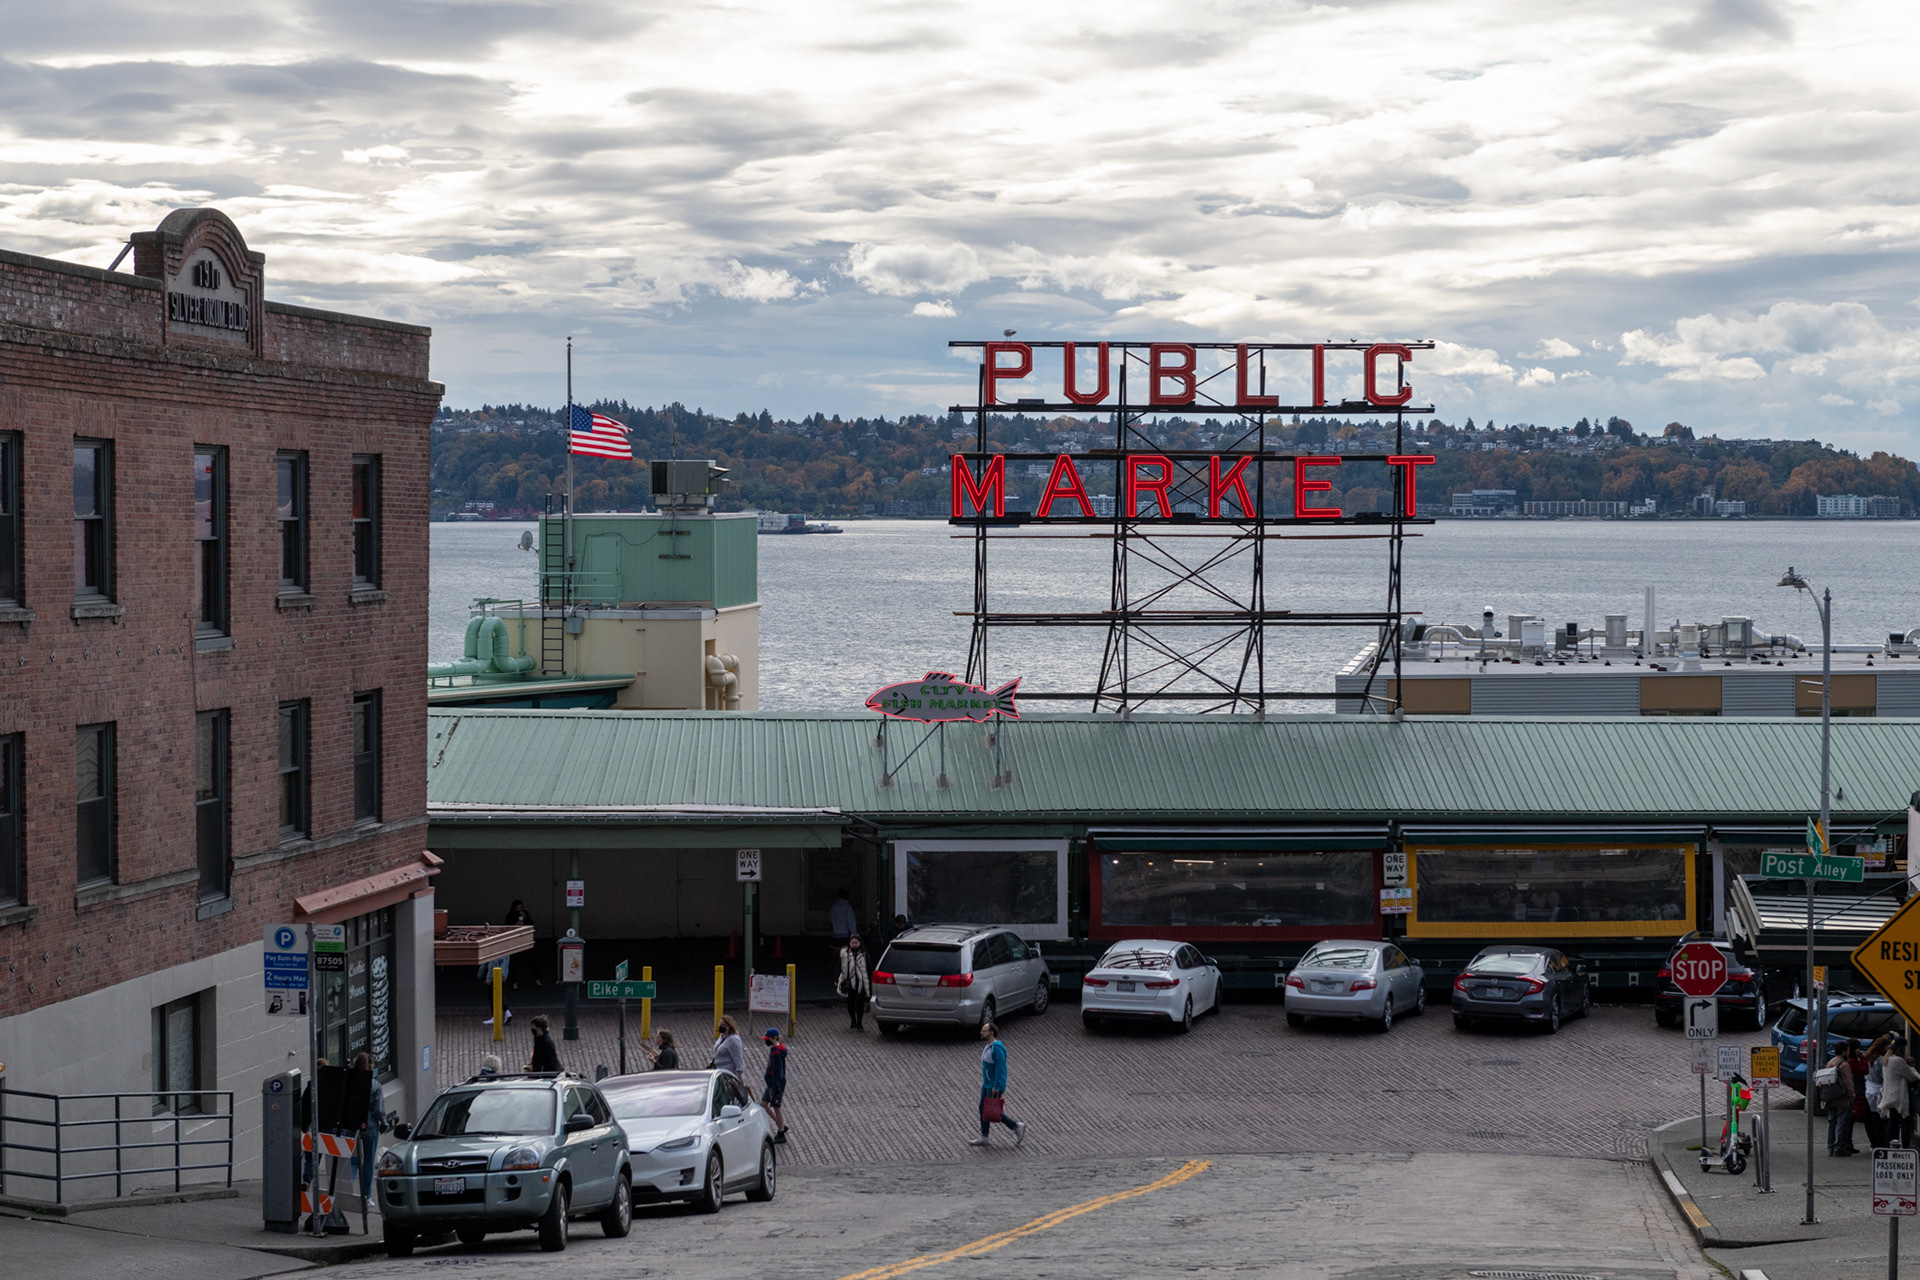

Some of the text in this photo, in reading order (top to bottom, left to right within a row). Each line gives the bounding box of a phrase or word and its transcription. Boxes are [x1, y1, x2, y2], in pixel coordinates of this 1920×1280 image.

[197, 260, 220, 289] 1910
[984, 341, 1413, 407] PUBLIC
[951, 453, 1437, 518] MARKET
[920, 684, 966, 695] CITY
[881, 699, 1001, 709] FISH MARKET
[739, 851, 758, 859] ONE
[1386, 854, 1405, 864] ONE
[739, 860, 759, 868] WAY
[1385, 864, 1405, 873] WAY
[1766, 855, 1861, 880] Post Alley 75
[280, 932, 292, 946] P
[1880, 940, 1919, 962] RESI
[265, 954, 277, 962] Pay
[316, 957, 343, 965] 87505
[1676, 960, 1723, 980] STOP
[266, 971, 273, 981] 2
[593, 983, 618, 995] Pike
[625, 987, 633, 995] Pl
[349, 1020, 366, 1035] BAKERY
[1688, 1028, 1715, 1037] ONLY
[1878, 1151, 1885, 1159] 3
[1876, 1162, 1914, 1170] PASSENGER
[1876, 1171, 1914, 1180] LOAD ONLY
